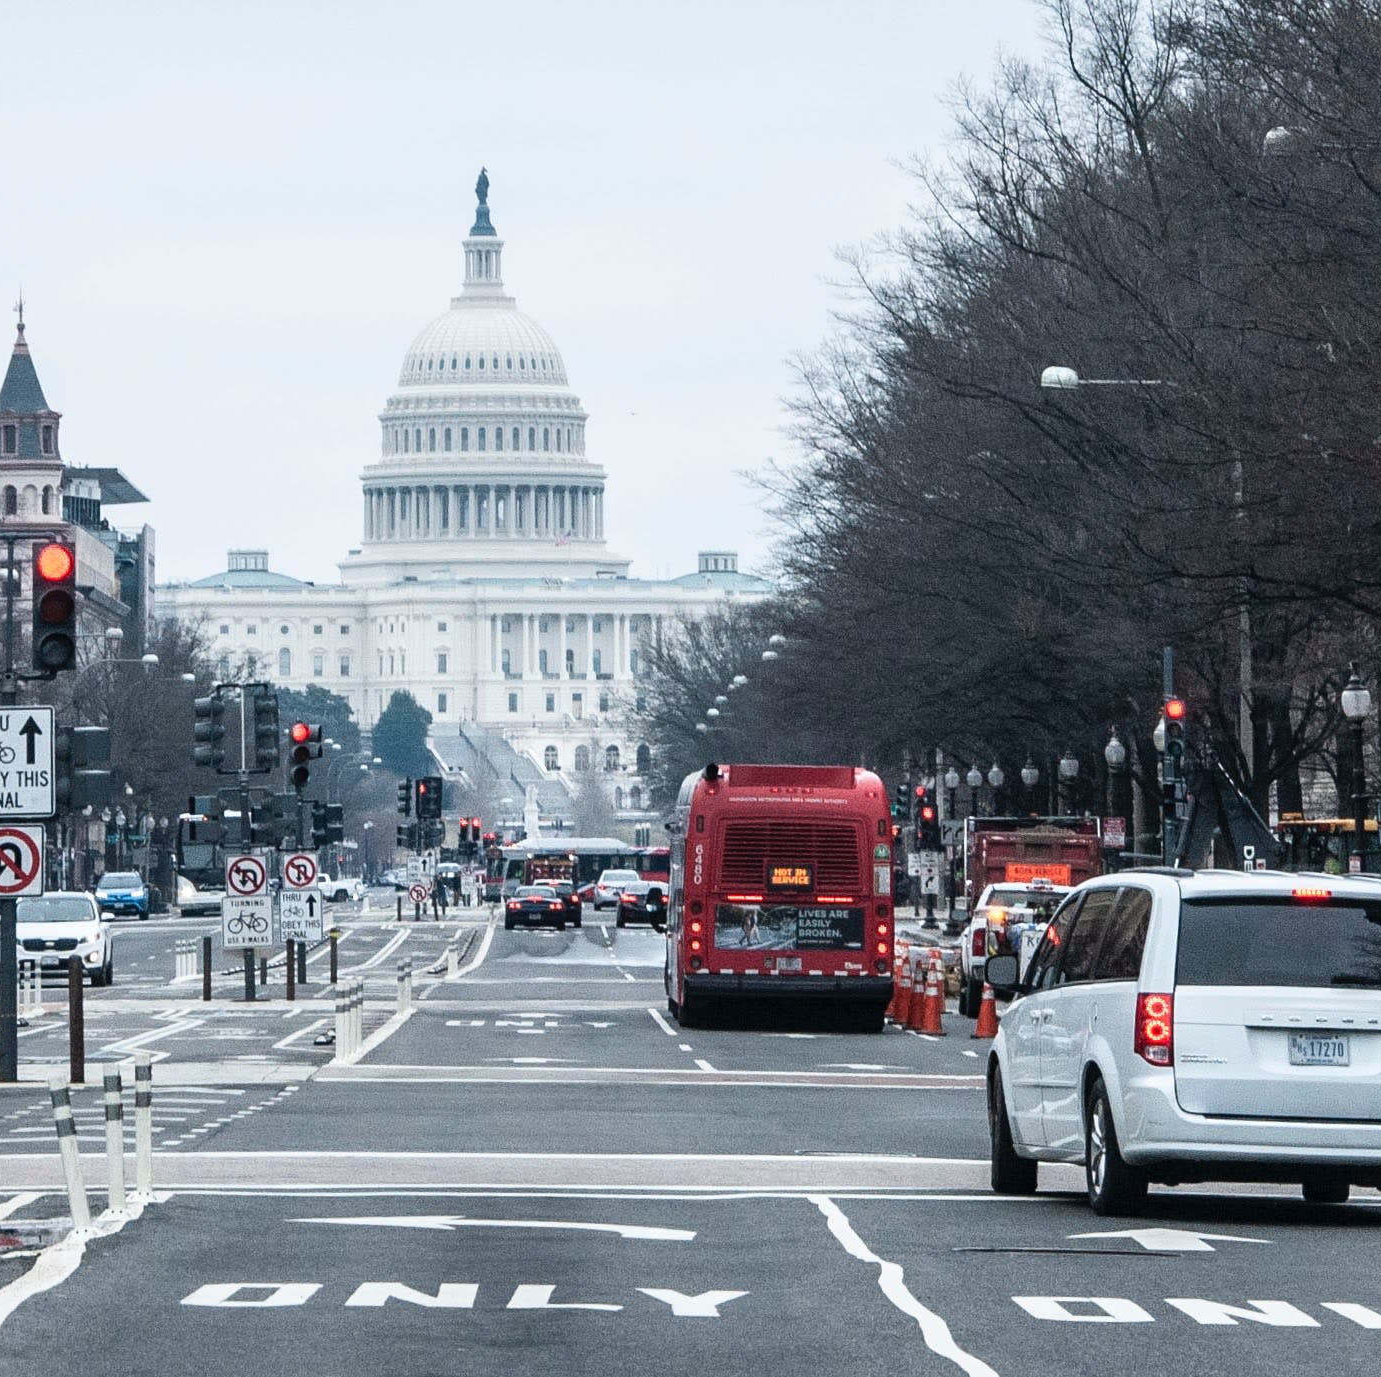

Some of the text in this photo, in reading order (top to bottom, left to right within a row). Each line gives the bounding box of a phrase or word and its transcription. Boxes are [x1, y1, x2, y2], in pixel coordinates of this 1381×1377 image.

[16, 770, 49, 787] THIS
[694, 844, 704, 884] 6480
[774, 868, 806, 876] NOT IN
[771, 876, 810, 885] SERVICE
[798, 910, 849, 919] LIVES ARE
[799, 919, 831, 927] EASILY
[799, 929, 843, 937] BROKEN.
[1309, 1041, 1344, 1057] 17270
[179, 1281, 751, 1317] ONLY
